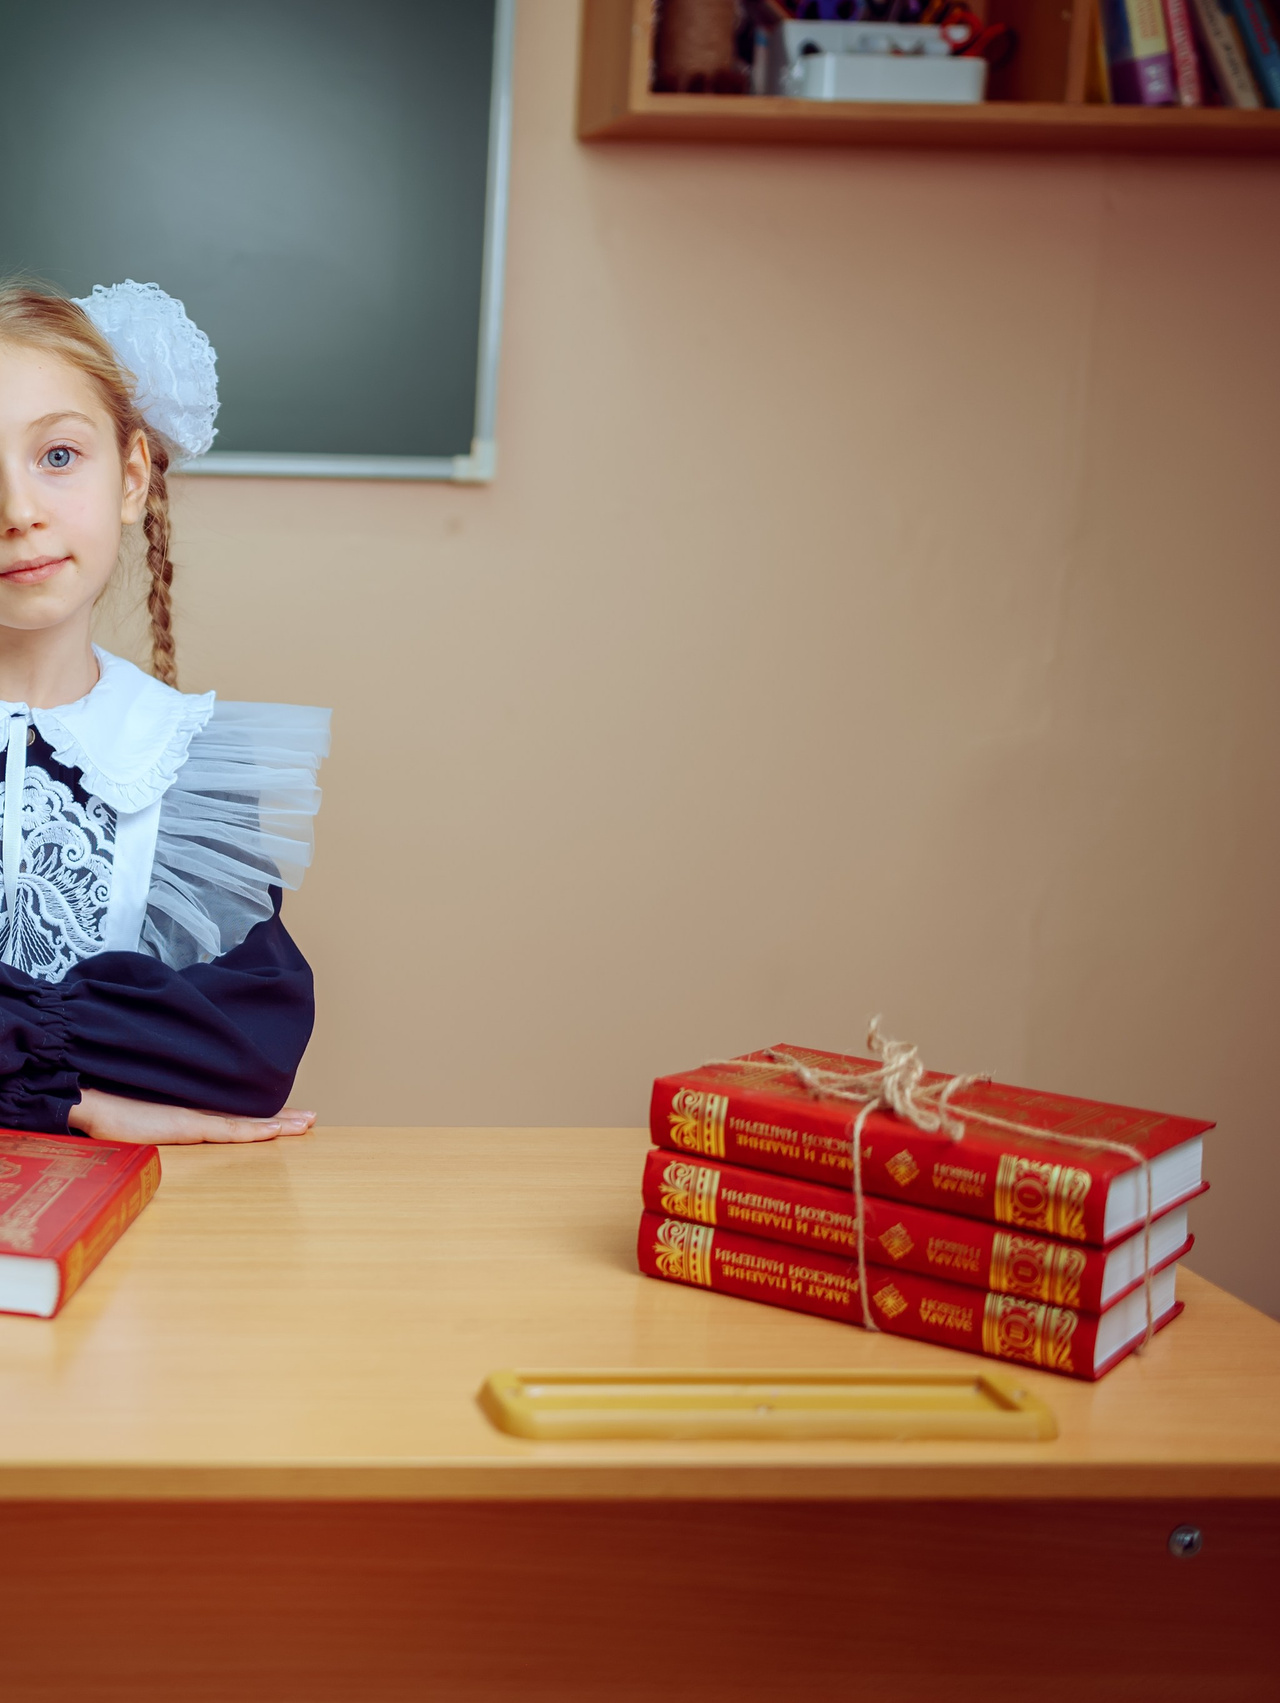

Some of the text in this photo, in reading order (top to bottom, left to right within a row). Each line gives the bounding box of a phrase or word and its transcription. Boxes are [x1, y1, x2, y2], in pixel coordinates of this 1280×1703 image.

[801, 1131, 873, 1159] РМСКОЙ
[803, 1147, 816, 1163] И
[819, 1152, 857, 1172] АКАТ
[721, 1188, 862, 1231] ИМСКОЙ ИМПЕРИИ
[727, 1204, 857, 1247] ЗАКАТ И ПАДЕНИЕ
[715, 1248, 785, 1275] ИМПЕРИИ
[722, 1263, 850, 1305] ЗАКАТ И ПАДЕНИЕ
